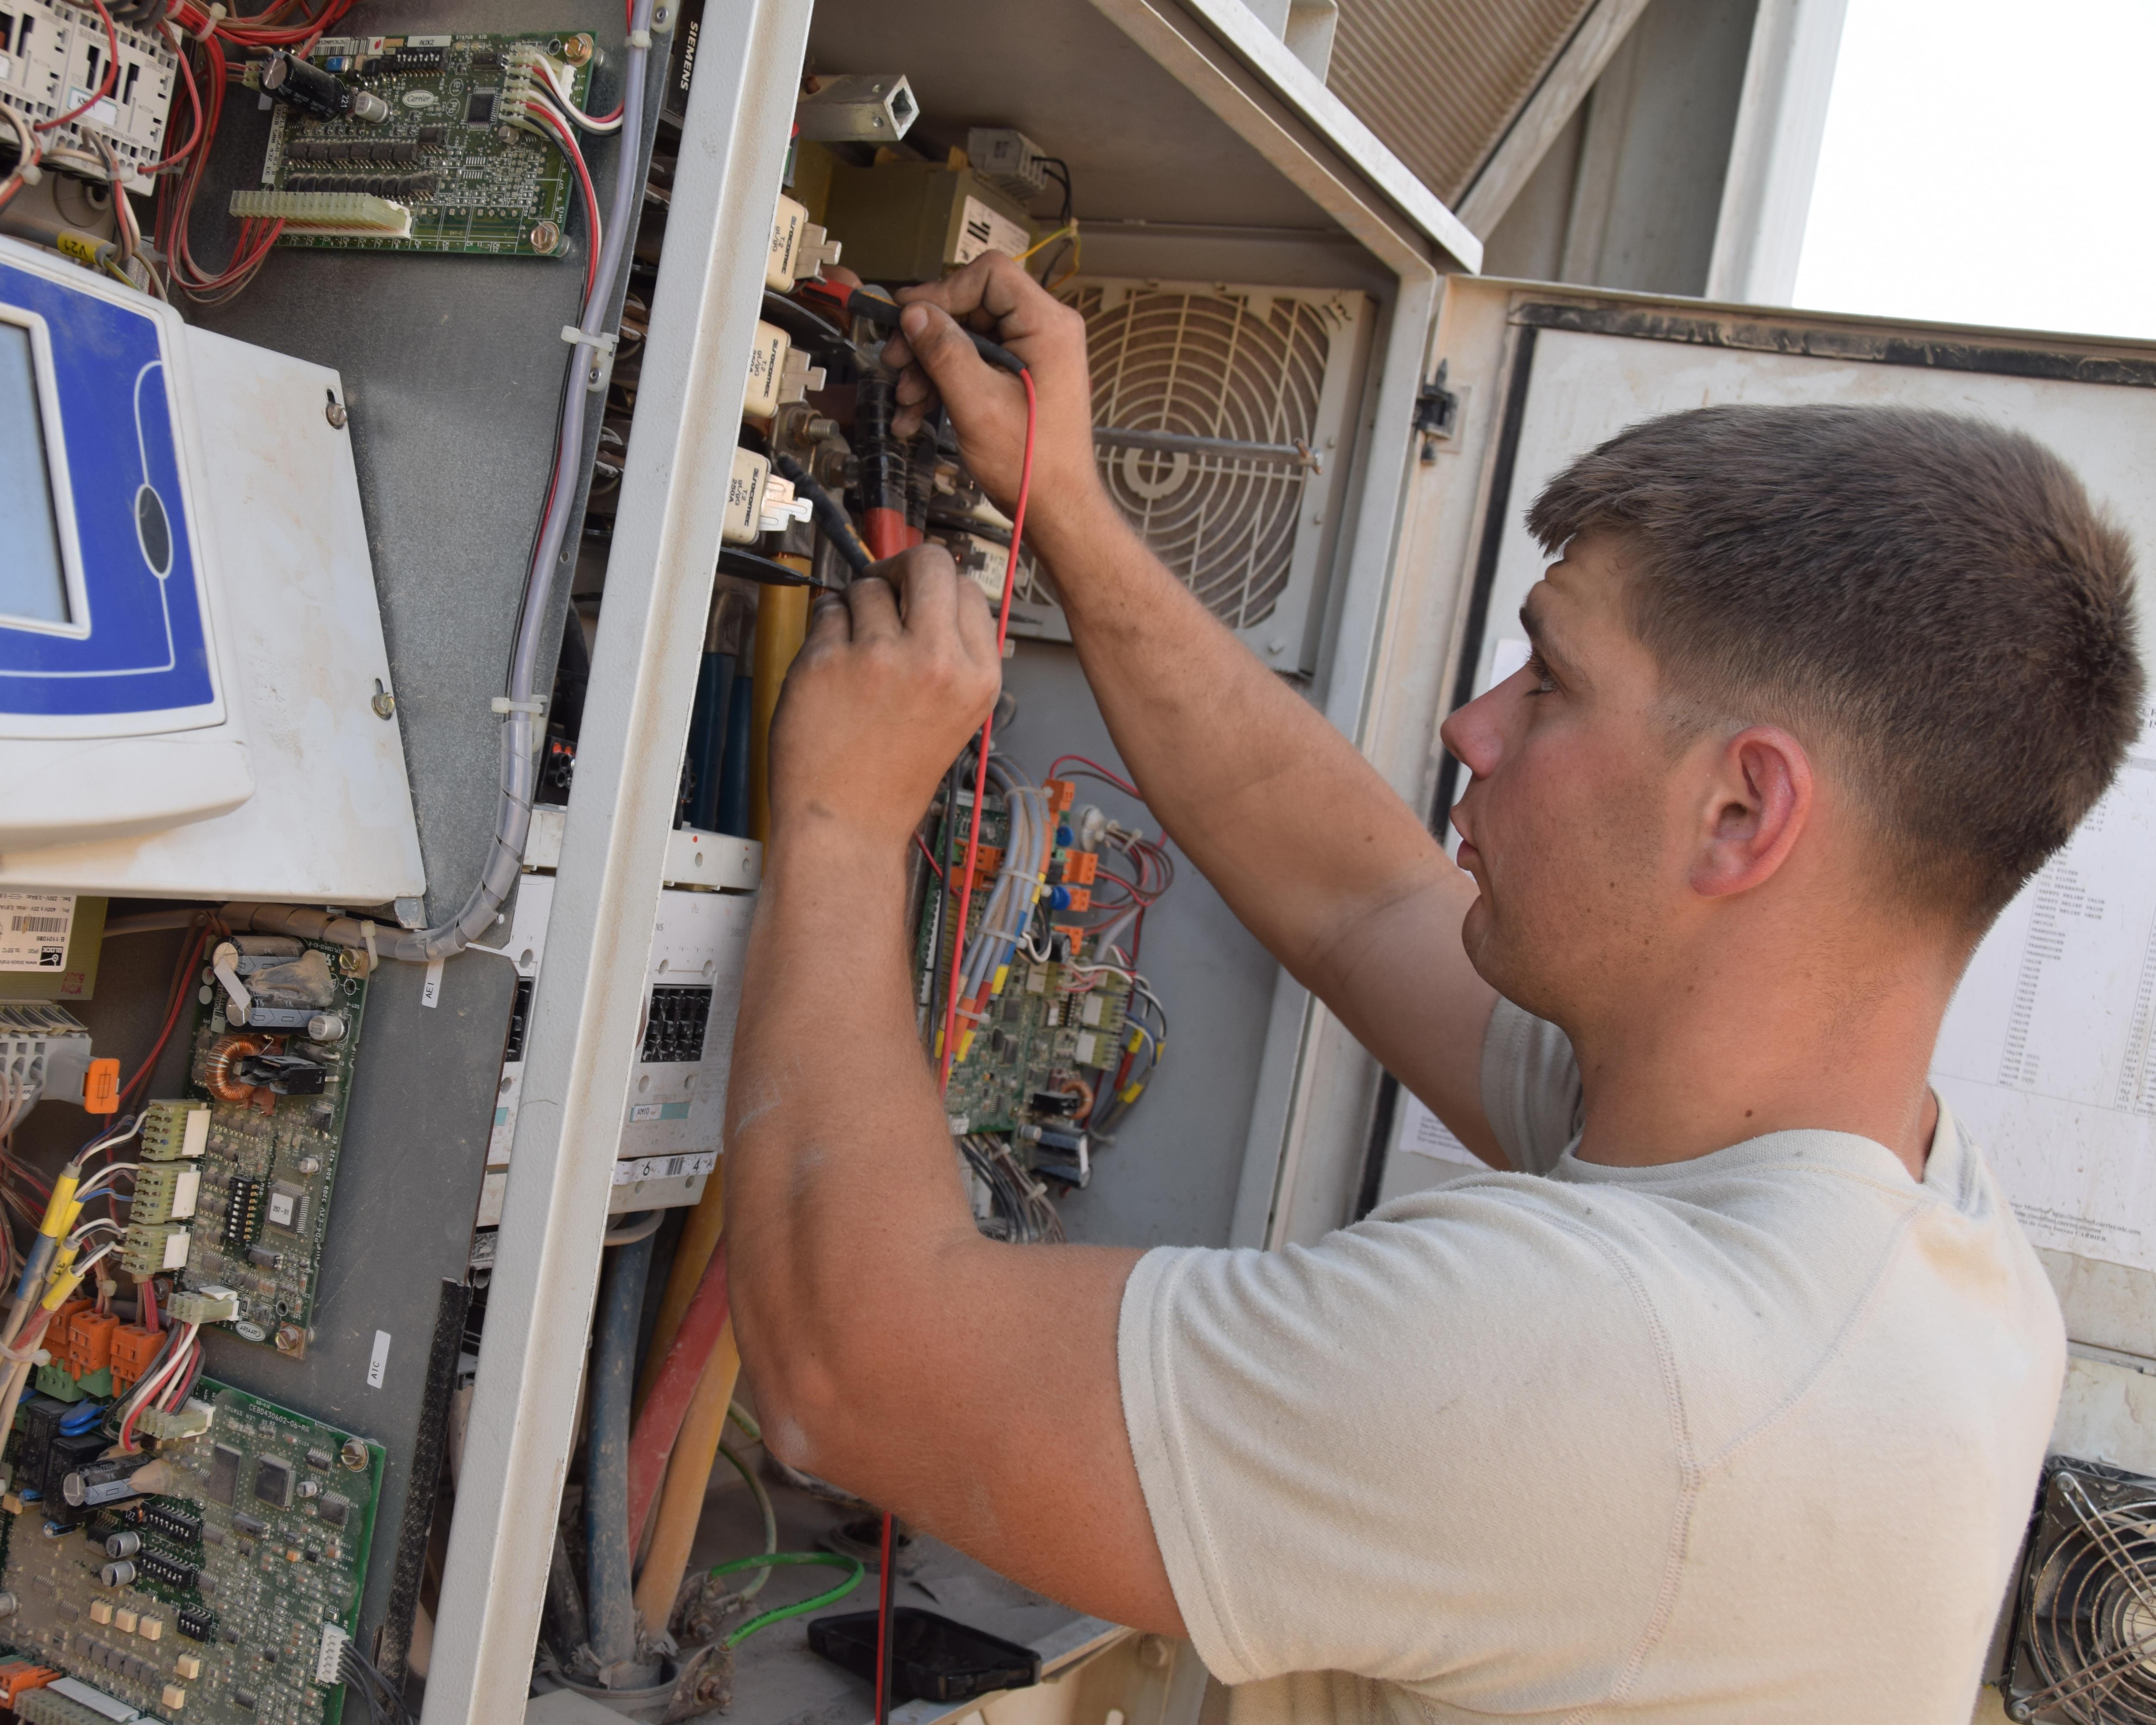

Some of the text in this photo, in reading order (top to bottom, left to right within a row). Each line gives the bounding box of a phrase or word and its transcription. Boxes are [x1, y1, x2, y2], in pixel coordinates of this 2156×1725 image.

[78, 28, 108, 47] SIEME
[680, 21, 699, 91] SIEMENS
[341, 94, 349, 108] 221
[729, 478, 737, 502] 250A
[693, 1157, 701, 1171] 4
[314, 1207, 326, 1243] PD4-EXV
[332, 1135, 338, 1144] EE
[239, 1326, 261, 1338] Carrier
[371, 1361, 379, 1379] A1C
[249, 1404, 309, 1433] CEBD430602-06-RA
